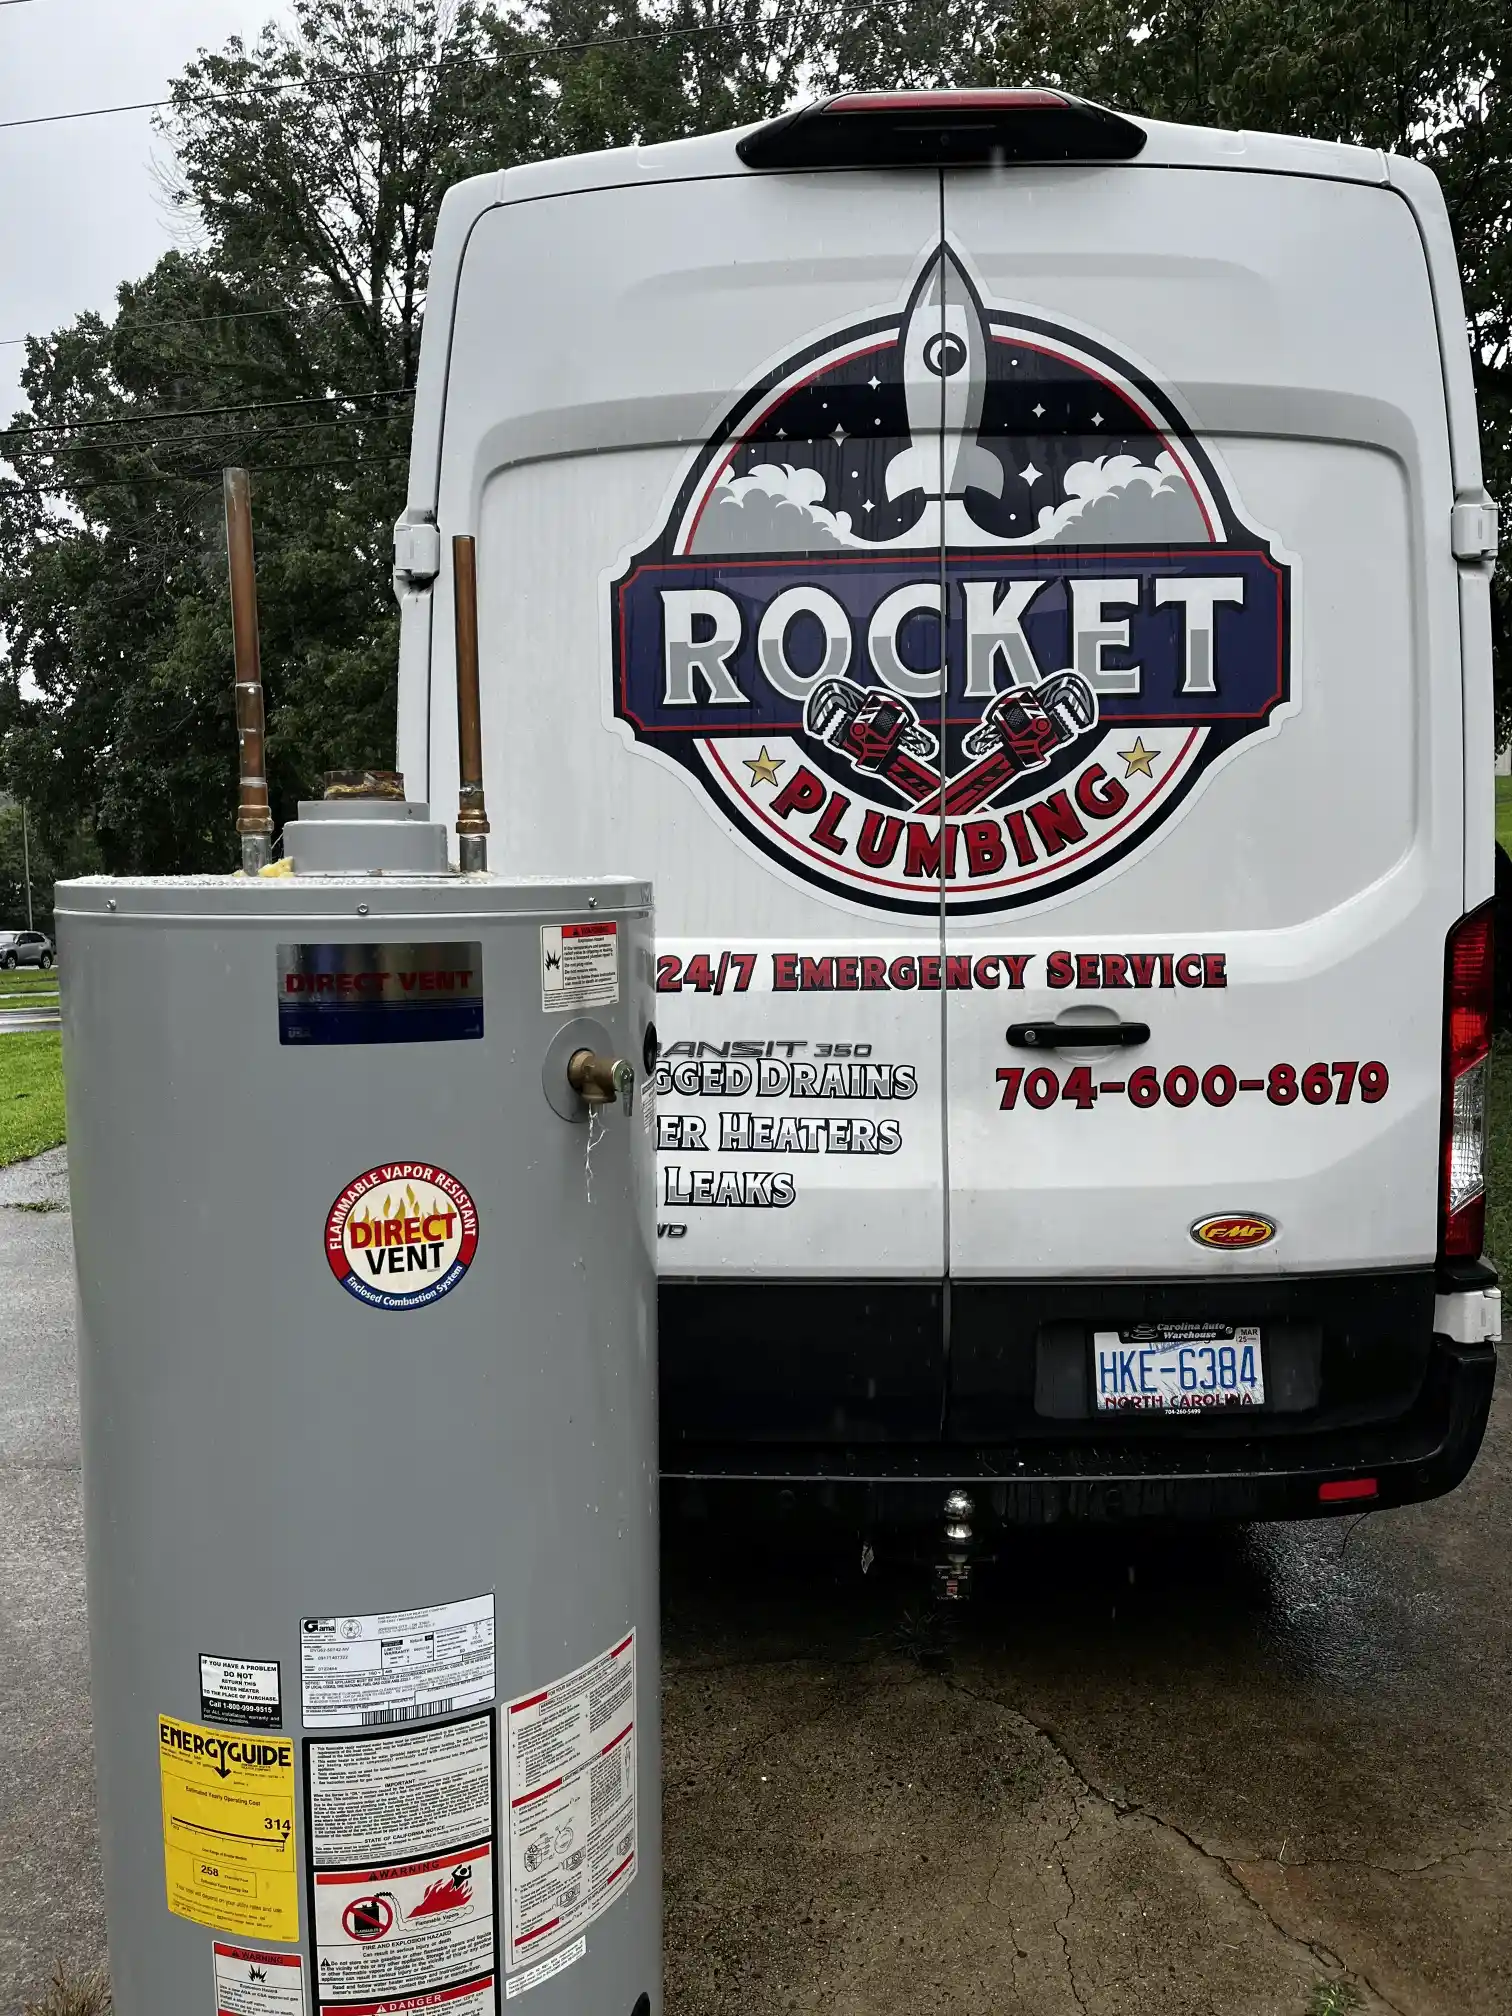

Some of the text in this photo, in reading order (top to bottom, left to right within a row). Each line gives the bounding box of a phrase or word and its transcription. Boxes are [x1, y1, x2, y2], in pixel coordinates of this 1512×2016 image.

[659, 576, 1244, 706] ROCKET
[771, 763, 1129, 880] PLUMBING
[285, 971, 473, 993] DIRECT VENT
[656, 952, 757, 995] 24/7
[772, 953, 1037, 992] EMERGENCY
[1046, 950, 1228, 990] SERVICE
[814, 1043, 872, 1058] 350
[756, 1058, 918, 1100] DRAINS
[996, 1060, 1389, 1110] 704-600-8679
[718, 1112, 903, 1155] HEATERS
[664, 1166, 796, 1208] LEAKS
[330, 1165, 476, 1249] FLAMMABLE VAPOR RESISTANT
[350, 1212, 457, 1249] DIRECT
[1206, 1225, 1266, 1238] FMF
[365, 1242, 444, 1275] VENT
[347, 1266, 462, 1306] Enclosed Combustion System
[1157, 1322, 1226, 1331] Carolina Auto
[1163, 1331, 1216, 1339] Warehouse
[1240, 1328, 1258, 1336] MAR
[1099, 1345, 1258, 1393] HKE-6384
[1105, 1395, 1163, 1410] NORTH
[209, 1700, 221, 1708] Call
[160, 1723, 292, 1770] ENERGYGUIDE
[385, 1778, 415, 1788] IMPORTANT
[185, 1786, 208, 1796] Estimated
[208, 1792, 222, 1801] Yearly
[223, 1795, 248, 1805] Operating
[264, 1817, 291, 1830] 314
[392, 1830, 424, 1840] CALIFORNIA
[426, 1825, 446, 1834] NOTICE
[201, 1865, 219, 1877] 258
[379, 1861, 440, 1879] WARNING
[378, 1942, 391, 1950] AND
[392, 1937, 426, 1948] EXPLOSION
[427, 1930, 452, 1941] HAZARD
[397, 1945, 415, 1954] serious
[241, 1951, 283, 1964] WARNING
[389, 1994, 442, 2011] DANGER
